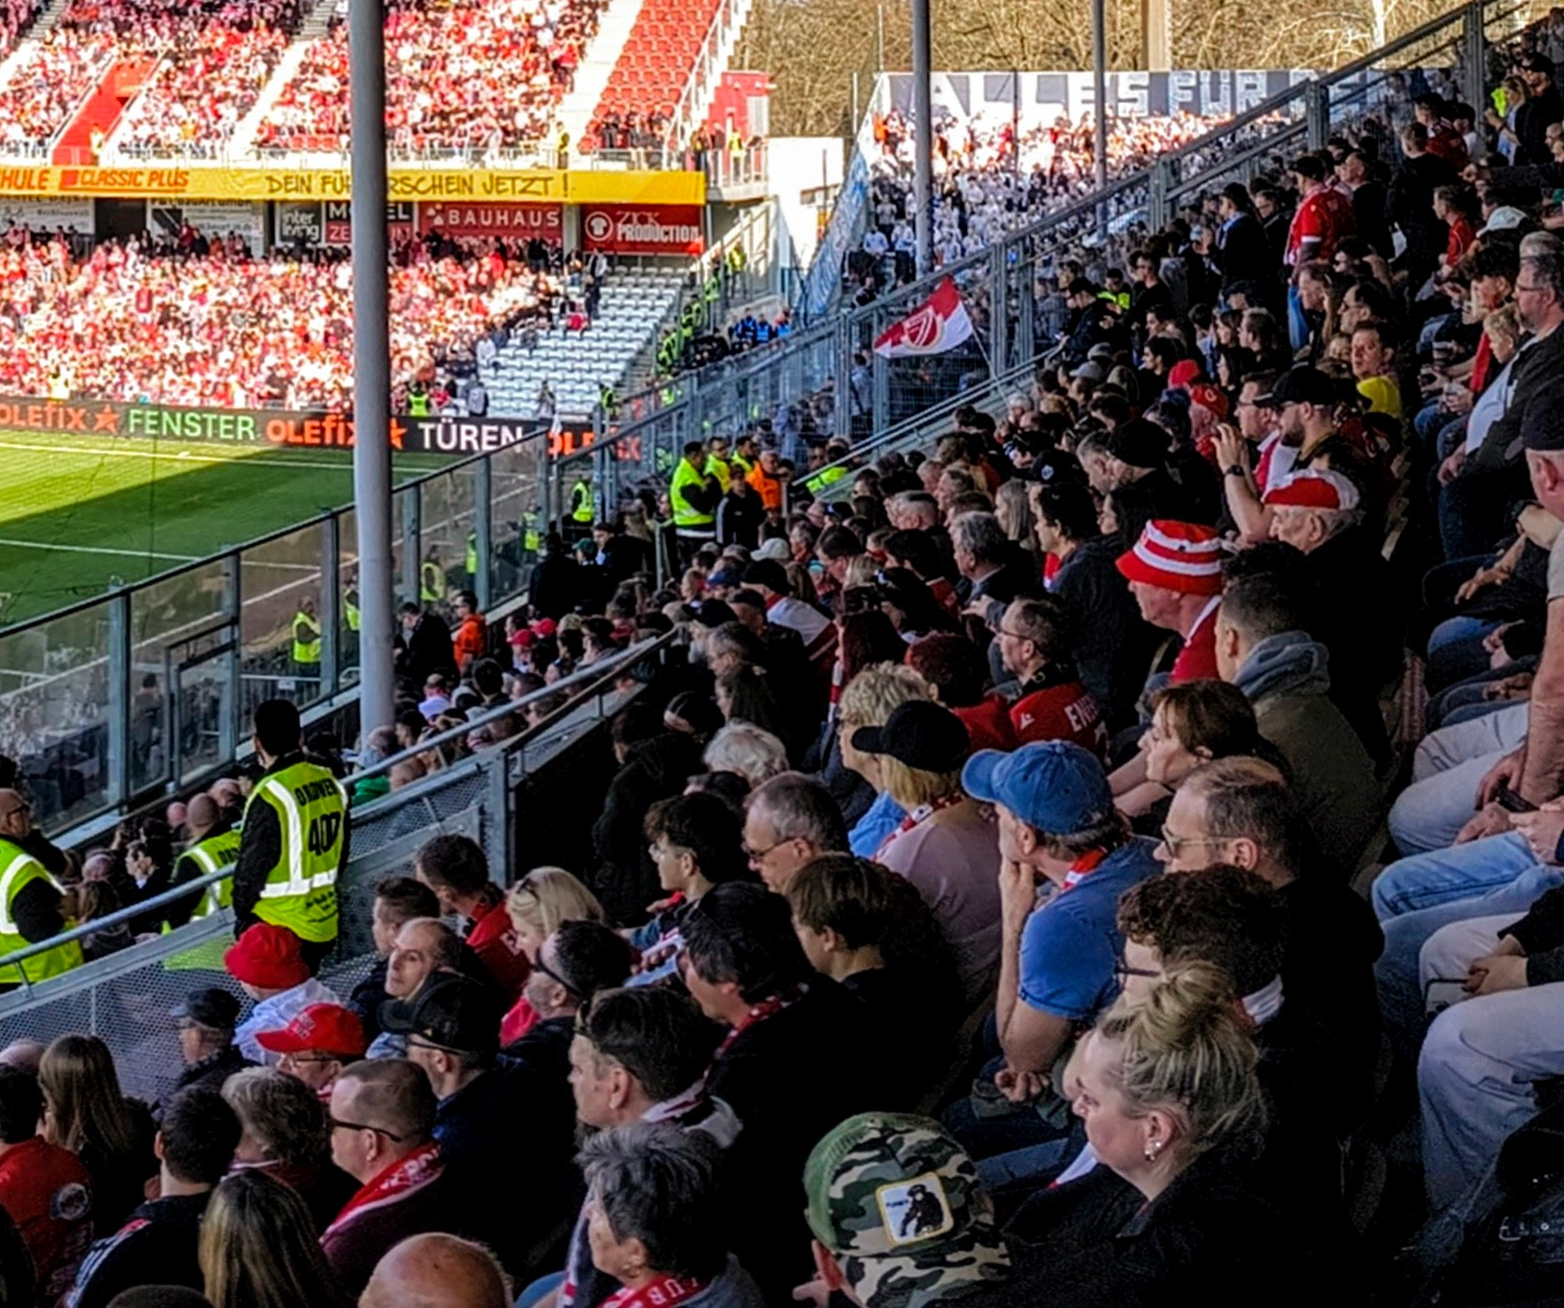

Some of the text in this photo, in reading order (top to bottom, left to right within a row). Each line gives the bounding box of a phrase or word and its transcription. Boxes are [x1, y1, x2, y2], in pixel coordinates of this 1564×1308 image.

[1168, 72, 1268, 118] FÜR
[79, 169, 145, 188] CLASSIC
[147, 170, 189, 188] PLUS
[266, 175, 312, 194] DEIN
[482, 174, 554, 197] JETZT
[283, 210, 315, 224] inter
[449, 209, 560, 227] BAUHAUS
[283, 223, 319, 241] living
[616, 224, 699, 243] PRODUCTION
[128, 409, 256, 441] FENSTER
[418, 415, 523, 451] TÜREN
